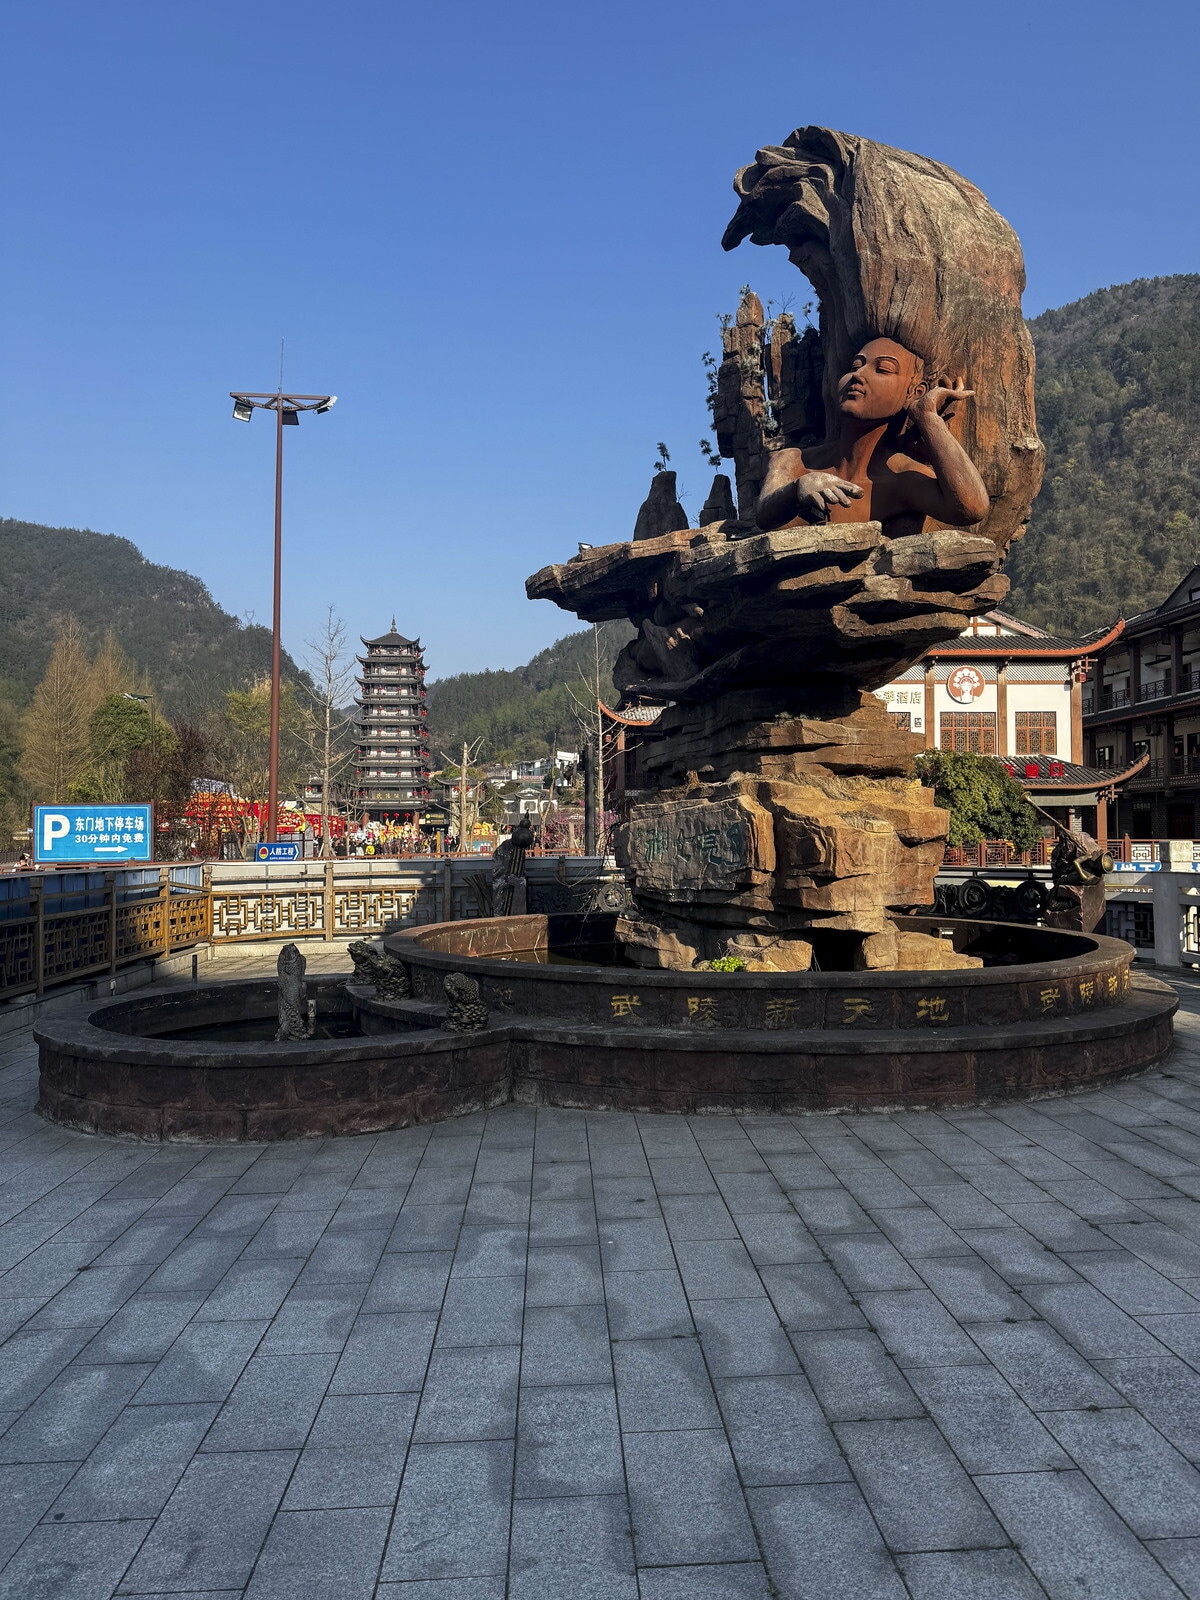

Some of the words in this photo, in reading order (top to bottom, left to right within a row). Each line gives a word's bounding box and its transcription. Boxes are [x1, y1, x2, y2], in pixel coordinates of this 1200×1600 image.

[75, 816, 144, 832] 东门地下停车场
[43, 814, 71, 851] P
[75, 833, 144, 843] 30分钟内免费
[269, 847, 294, 856] 人防工程
